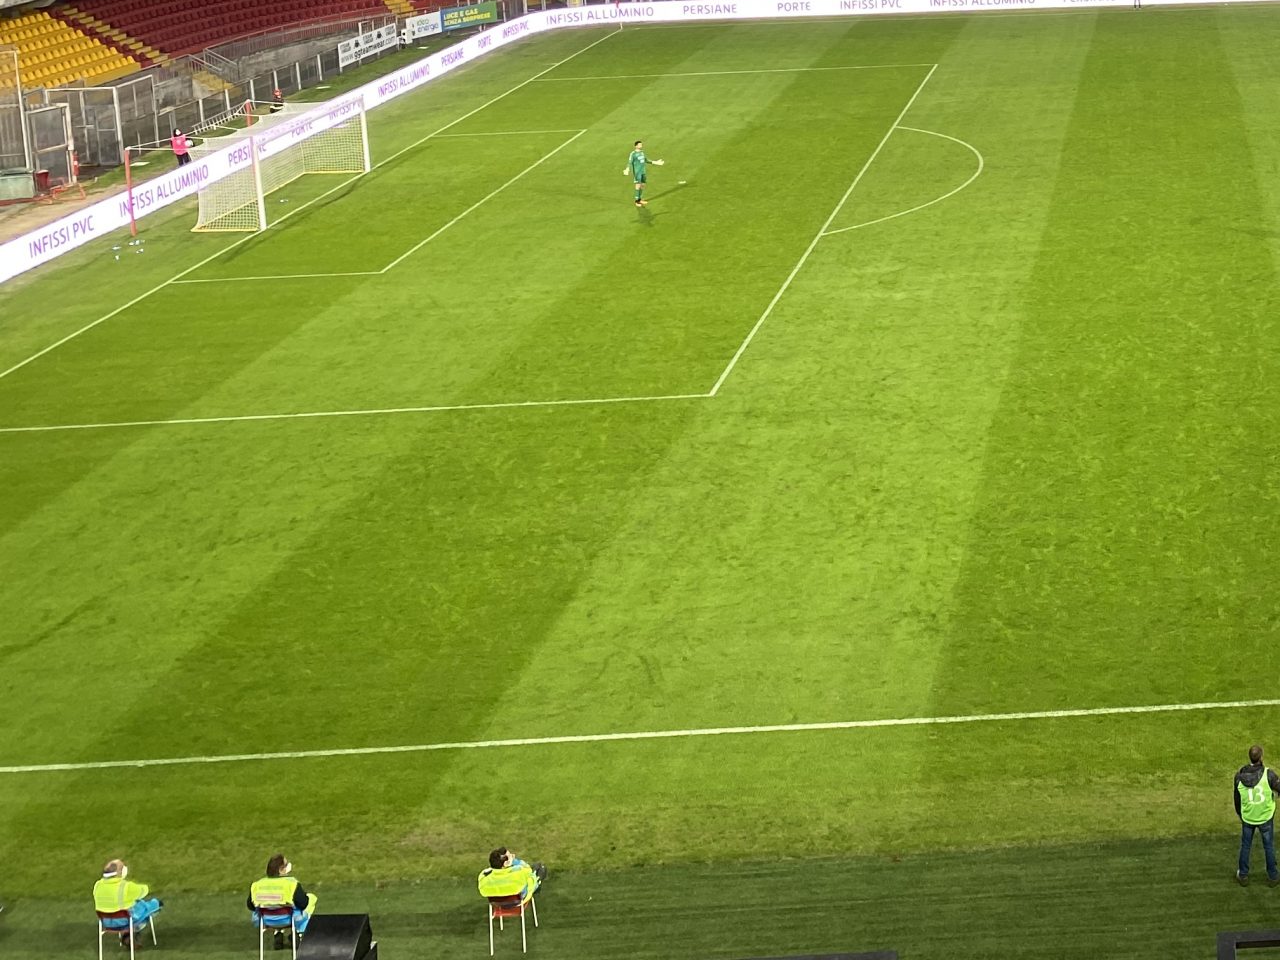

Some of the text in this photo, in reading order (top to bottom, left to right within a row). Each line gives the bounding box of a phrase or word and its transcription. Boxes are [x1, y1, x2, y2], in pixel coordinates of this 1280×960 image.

[441, 48, 464, 67] PERSIANE
[478, 36, 492, 49] PORTE
[502, 22, 519, 38] INFISSI
[520, 20, 530, 31] PVC
[546, 12, 583, 26] INFISSI
[586, 6, 654, 22] ALLUMINIO
[682, 4, 738, 15] PERSIANE
[777, 1, 811, 12] PORTE
[840, 0, 878, 10] INFISSI
[378, 64, 430, 98] INFISSI ALLUMINIO
[119, 164, 209, 218] INFISSI ALLUMINIO
[29, 215, 95, 259] INFISSI PVC
